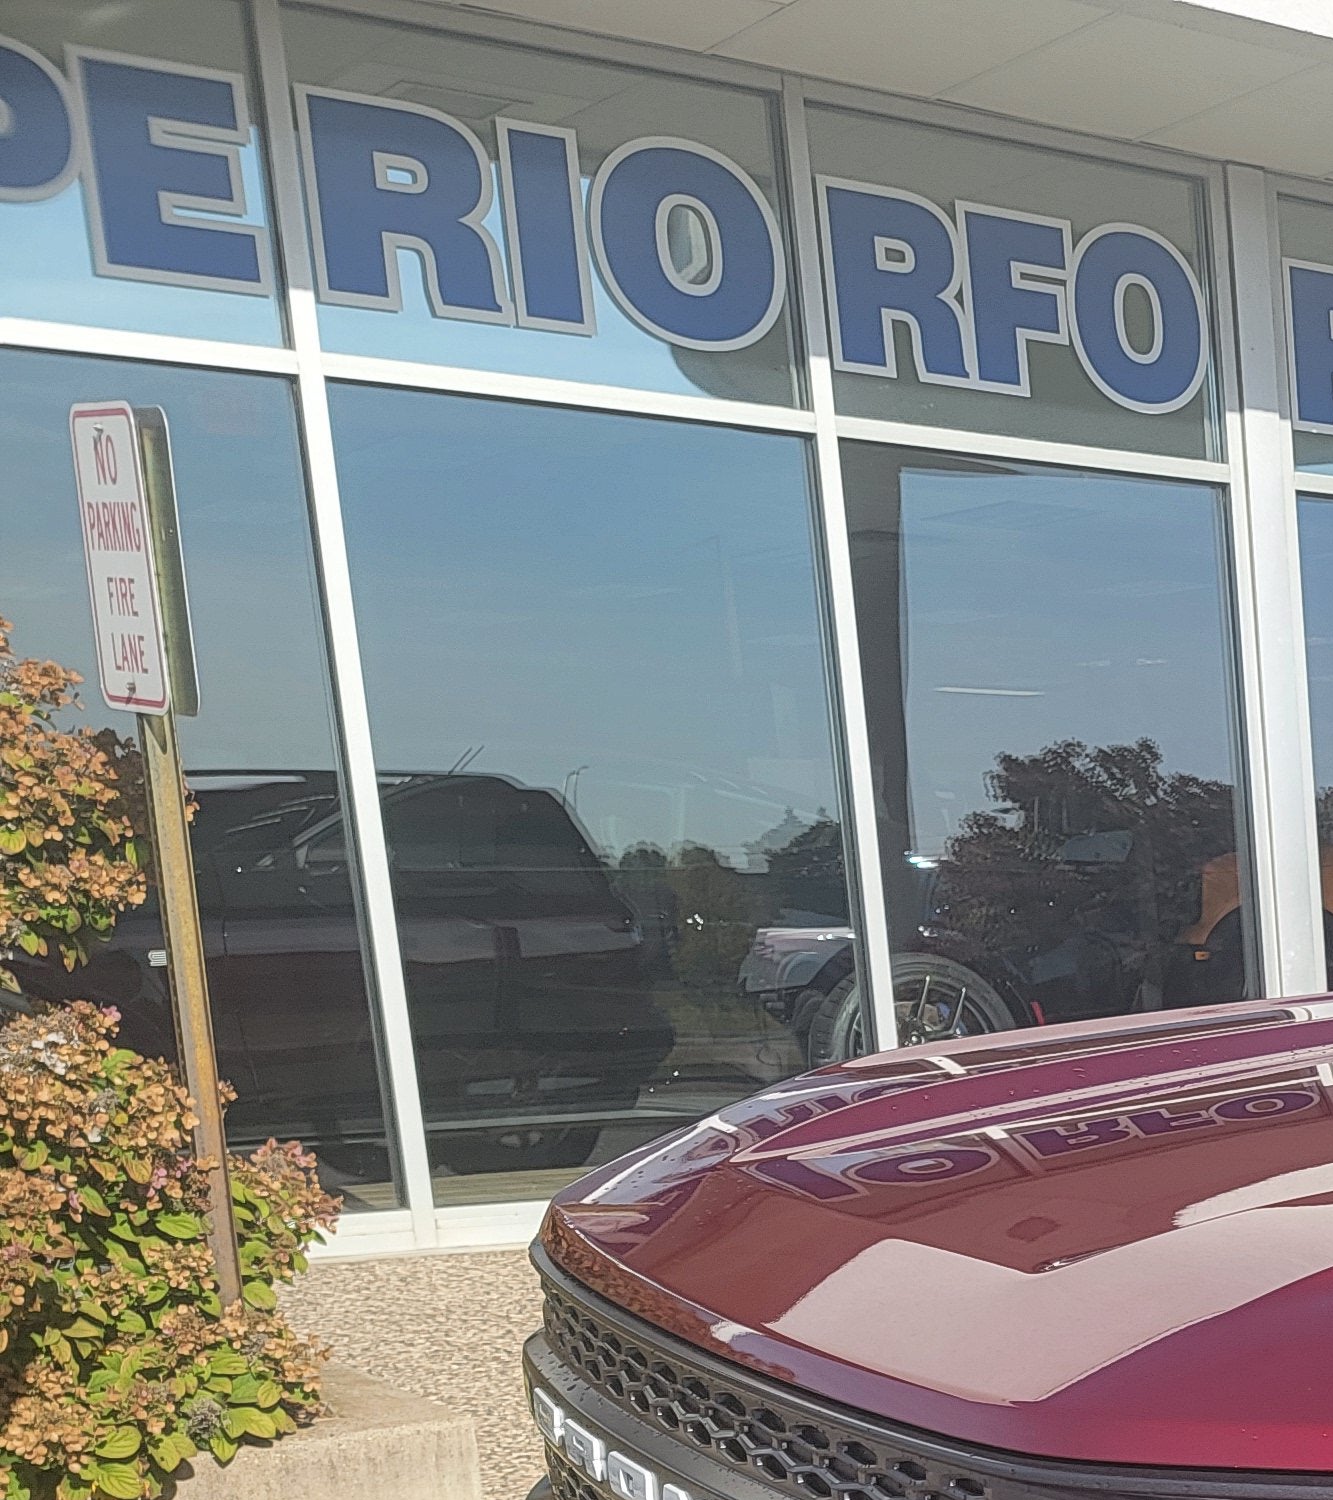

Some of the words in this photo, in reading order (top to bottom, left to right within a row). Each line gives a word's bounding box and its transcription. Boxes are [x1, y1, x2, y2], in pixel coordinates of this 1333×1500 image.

[92, 434, 118, 486] NO
[86, 501, 141, 552] PARKING
[106, 577, 139, 618] FIRE
[110, 632, 149, 675] LANE
